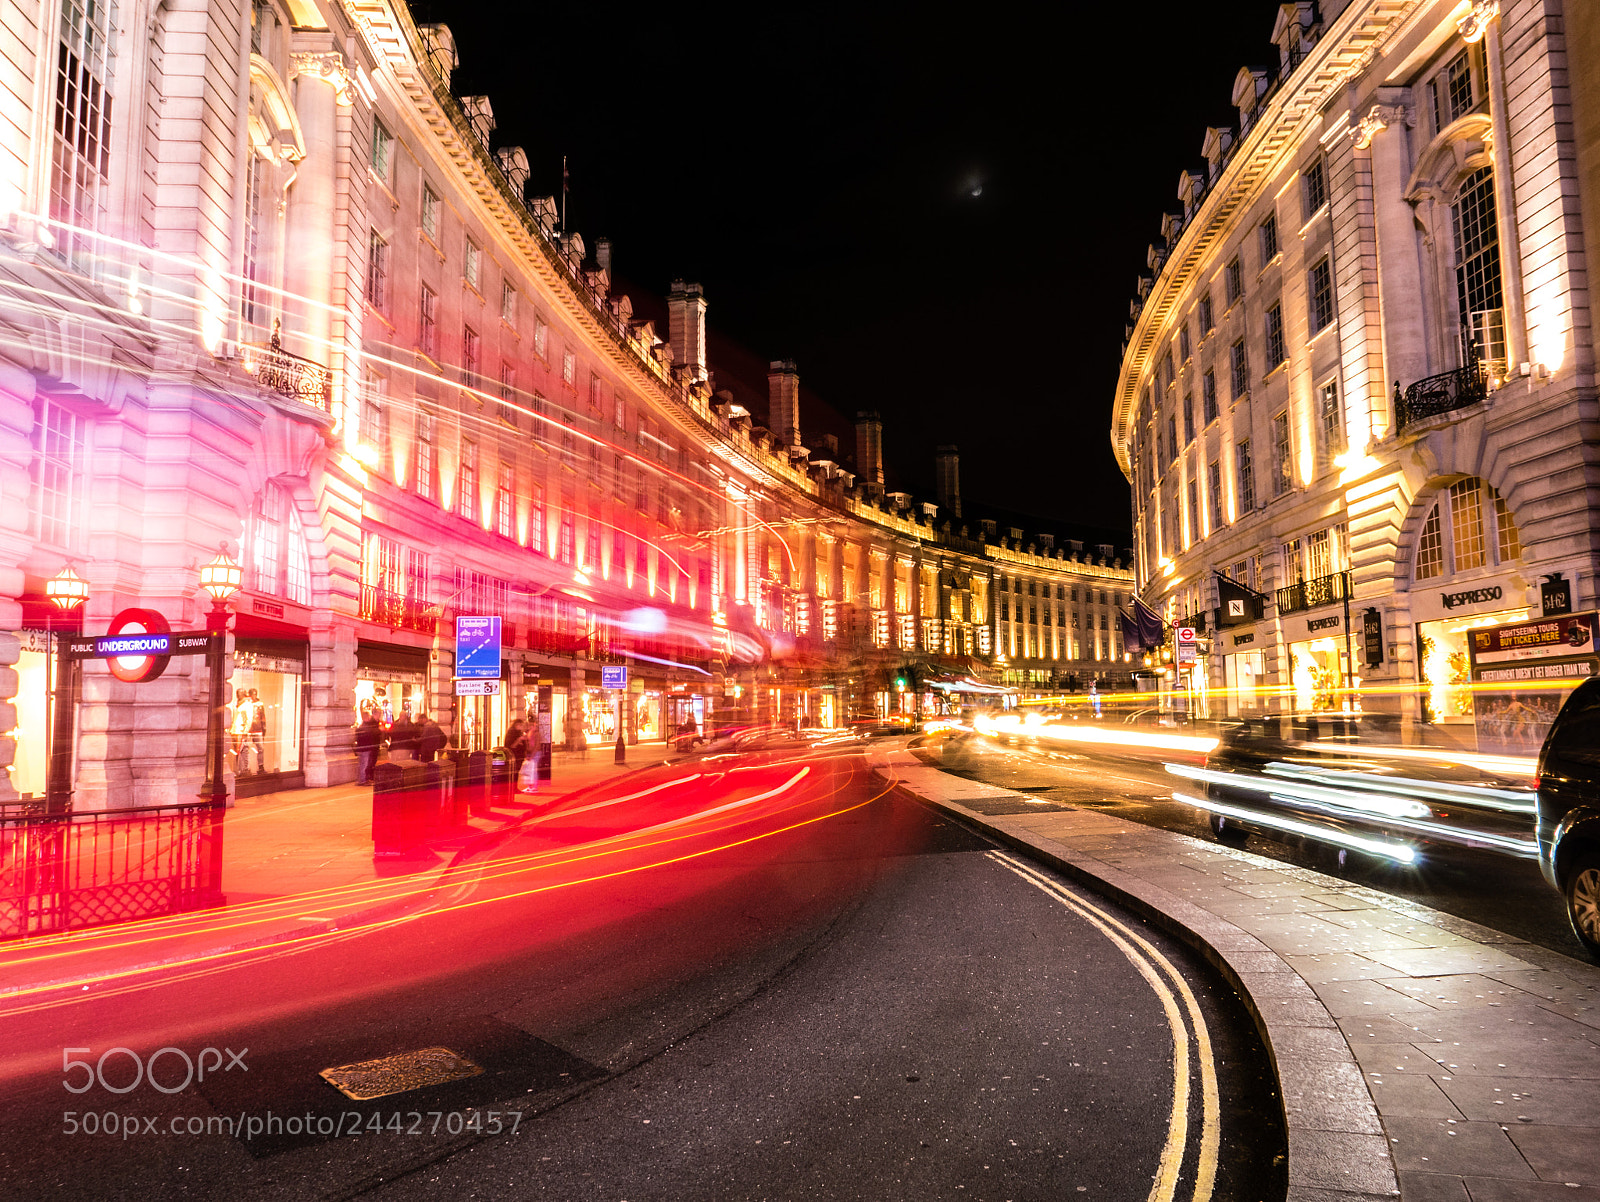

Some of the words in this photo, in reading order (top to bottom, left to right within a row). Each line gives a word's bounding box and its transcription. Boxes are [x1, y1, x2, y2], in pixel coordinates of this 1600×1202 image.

[1440, 585, 1503, 610] NESPRESSO
[1306, 615, 1340, 633] NESPRESSO
[1499, 625, 1538, 638] SIGHTSEEING
[1538, 622, 1559, 632] TOURS
[70, 644, 93, 652] PUBLIC
[98, 639, 168, 652] UNDERGROUND
[178, 638, 208, 647] SUBWAY
[1500, 637, 1513, 647] BUY
[1514, 634, 1540, 645] TICKETS
[1541, 631, 1560, 641] HERE
[1480, 669, 1515, 682] ENTERTAINMENT
[1515, 667, 1535, 680] DOESN'T
[1535, 666, 1544, 678] GET
[1545, 665, 1563, 678] BIGGER
[1563, 664, 1578, 676] THAN
[1578, 662, 1591, 674] THIS
